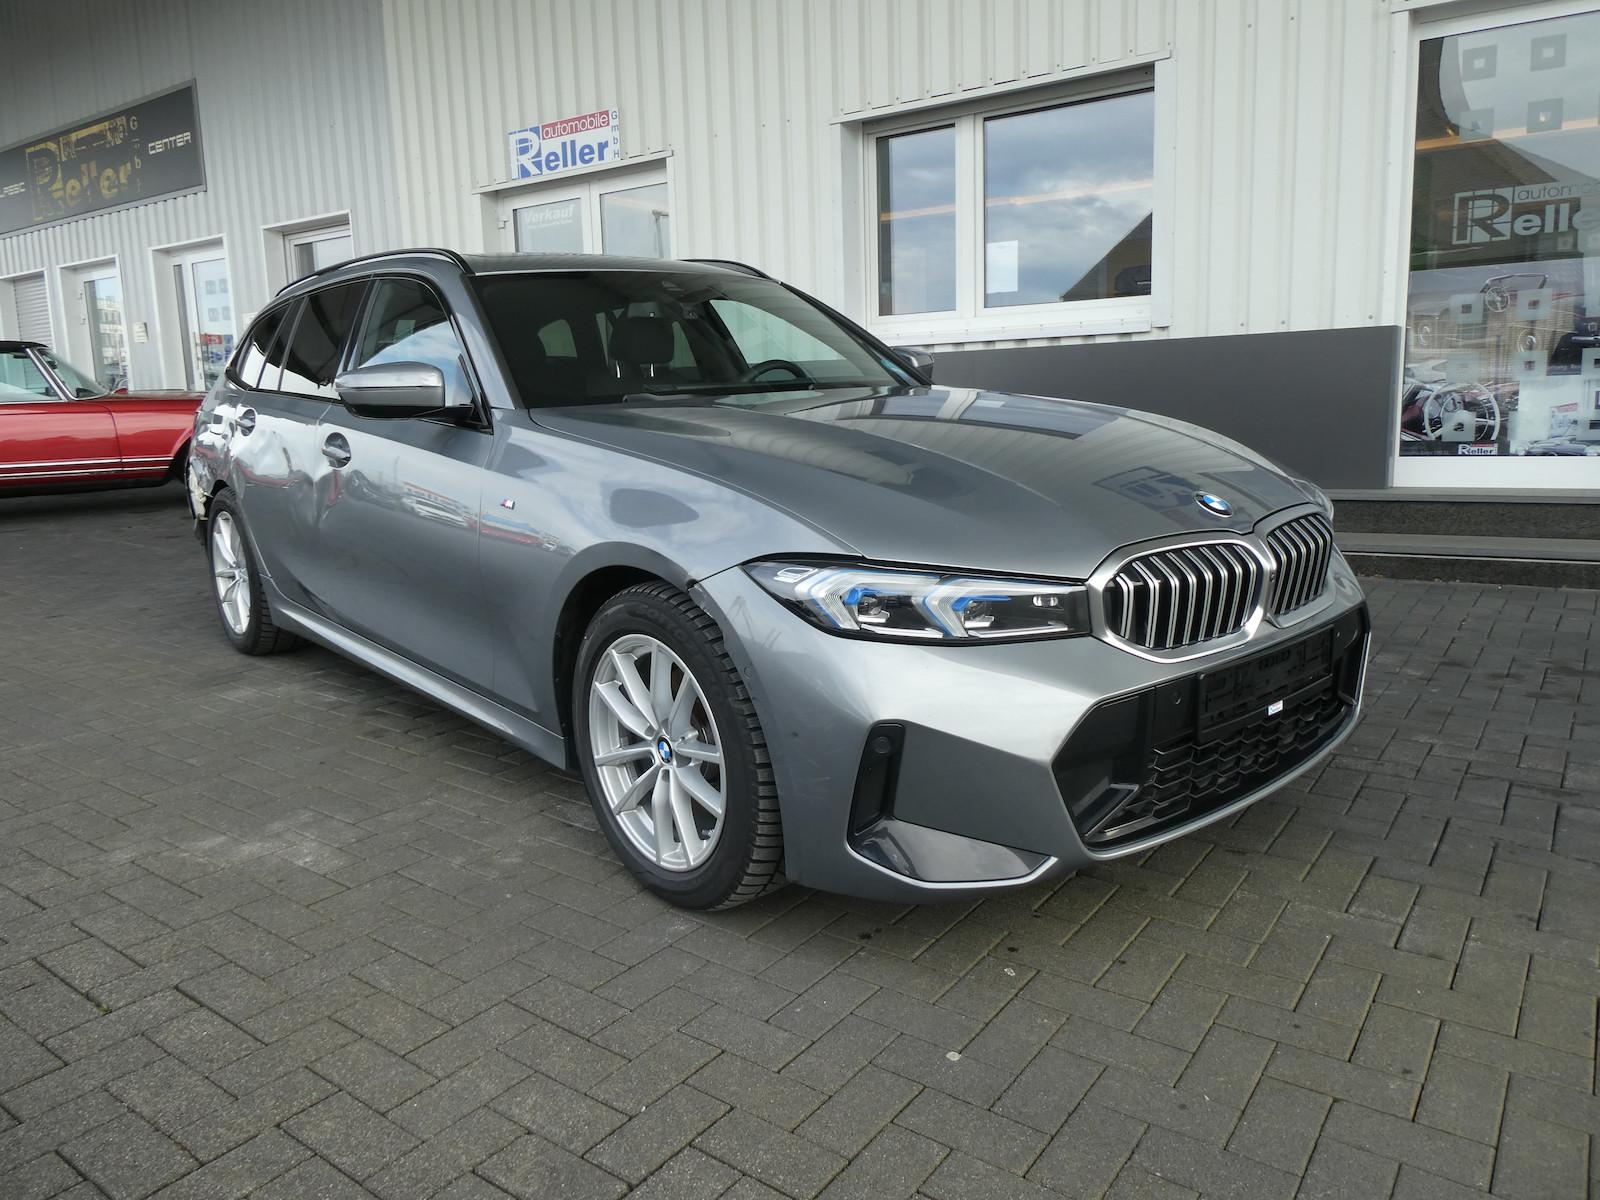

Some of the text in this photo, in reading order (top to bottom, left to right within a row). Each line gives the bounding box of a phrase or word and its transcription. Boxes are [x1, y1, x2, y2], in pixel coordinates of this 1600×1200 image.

[542, 112, 609, 140] automobile
[148, 131, 191, 155] CENTER
[508, 126, 609, 180] Reller
